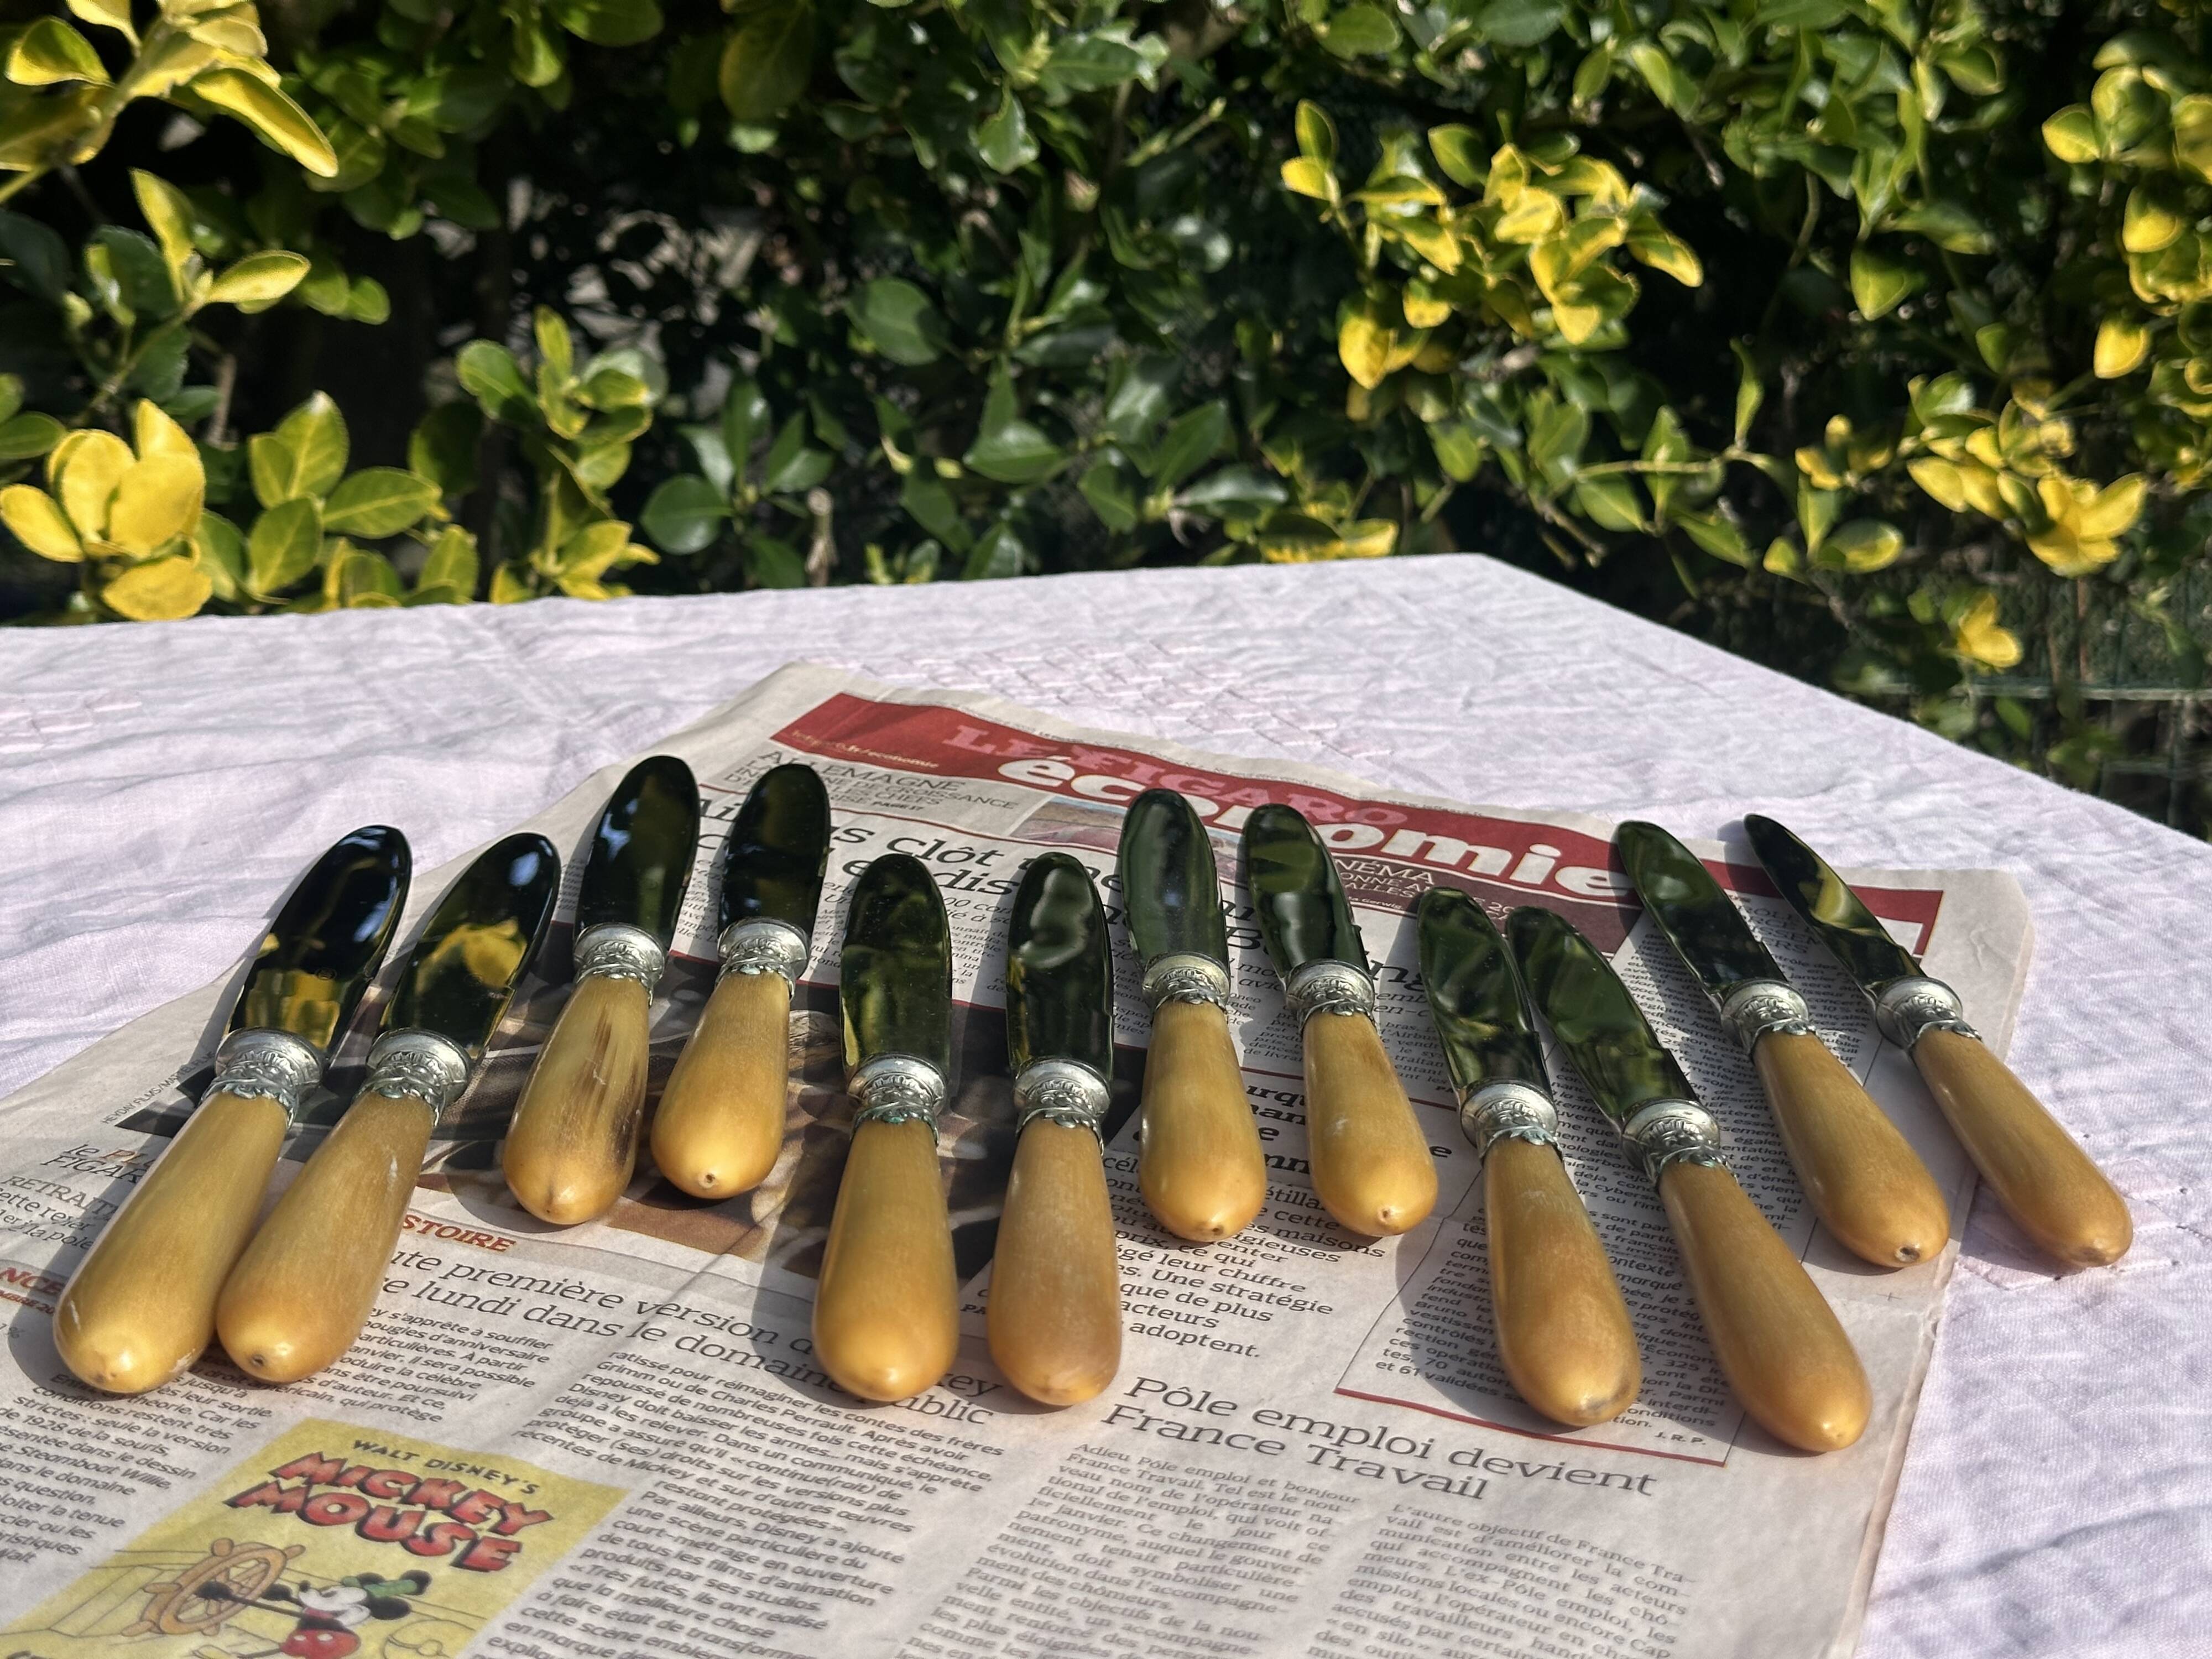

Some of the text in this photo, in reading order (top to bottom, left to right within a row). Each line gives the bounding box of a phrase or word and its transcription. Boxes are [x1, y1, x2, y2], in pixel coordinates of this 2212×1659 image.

[761, 750, 966, 791] AEMAGNE
[998, 755, 1635, 897] écomie
[100, 1103, 136, 1124] HEYDAY
[63, 1144, 100, 1156] le
[0, 1192, 40, 1212] ette
[1272, 1208, 1340, 1231] cette
[1274, 1227, 1386, 1258] maisons
[1160, 1256, 1307, 1293] leur chiffre
[1214, 1254, 1257, 1269] qui
[439, 1260, 779, 1346] première version
[1120, 1282, 1275, 1322] que de plus
[1150, 1269, 1334, 1315] Une stratégie
[411, 1281, 520, 1316] lundi
[524, 1306, 625, 1338] dans
[625, 1321, 667, 1342] le
[388, 1312, 470, 1333] s'apprête
[485, 1332, 553, 1350] souffler
[429, 1332, 550, 1363] d'anniversaire
[1129, 1321, 1261, 1358] adoptent.
[416, 1370, 482, 1390] célèbre
[420, 1359, 535, 1388] sera possible
[475, 1357, 528, 1371] partir
[1425, 1357, 1448, 1369] 70
[180, 1391, 272, 1418] leur sortie.
[352, 1373, 478, 1402] être poursuivi
[609, 1351, 1005, 1456] ratissé pour réimaginer les contes des frères
[22, 1415, 68, 1431] 1928
[123, 1408, 189, 1430] restent
[194, 1426, 235, 1440] très
[198, 1410, 262, 1431] Car les
[340, 1398, 372, 1413] qui
[369, 1401, 442, 1423] protège
[537, 1407, 687, 1448] groupe assuré
[581, 1373, 992, 1482] repoussé de nombreuses fois cette échéance,
[597, 1360, 969, 1462] Grimm ou de Charles Perrault. Après avoir
[0, 1426, 198, 1479] ésentée dans dessin
[92, 1417, 231, 1455] seule version
[554, 1395, 914, 1492] déjà les relever. Dans un communiqué,
[567, 1383, 984, 1493] Disney doit baisser les mais s'apprête
[1101, 1402, 1488, 1500] France Travail
[1123, 1376, 1658, 1498] Pôle emploi devient
[14, 1446, 121, 1475] Steamboat
[353, 1439, 541, 1495] WALT DISNEY'S
[511, 1428, 598, 1458] récentes
[623, 1458, 696, 1480] Mickey
[754, 1492, 835, 1515] d'autres
[523, 1419, 911, 1516] protéger (ses) droits versions plus
[1065, 1452, 1131, 1475] France
[1074, 1442, 1360, 1505] Adieu Pôle emploi bonjour
[55, 1472, 137, 1495] domaine
[268, 1451, 555, 1537] MICKEY
[69, 1509, 126, 1527] tenue
[222, 1480, 523, 1573] MOUSE
[753, 1522, 822, 1545] Disney
[792, 1564, 895, 1595] ouverture
